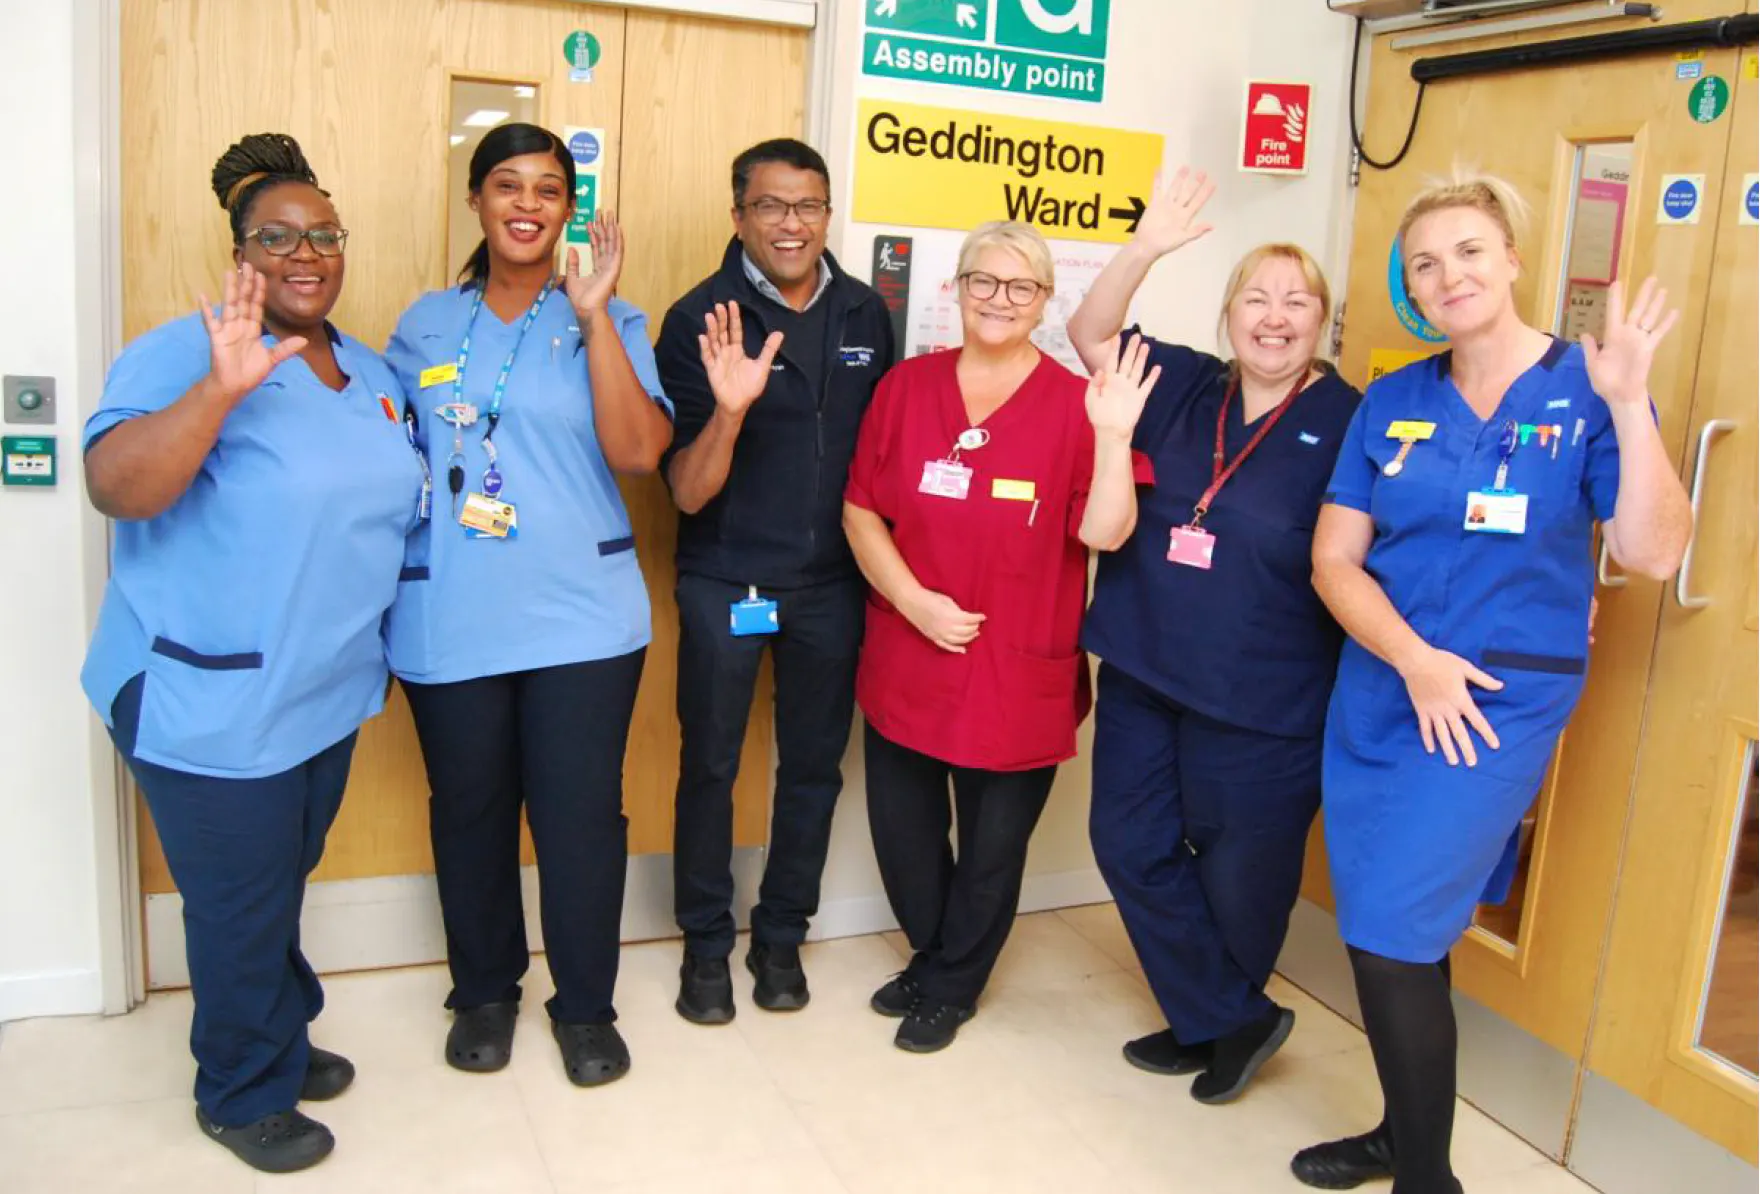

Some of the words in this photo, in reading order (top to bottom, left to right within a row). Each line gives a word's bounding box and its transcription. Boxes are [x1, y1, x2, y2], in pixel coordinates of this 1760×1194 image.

[873, 40, 1016, 87] Assembly
[1026, 64, 1096, 92] point
[867, 112, 1104, 178] Geddington
[1256, 153, 1290, 167] point
[1261, 138, 1287, 151] Fire
[1003, 183, 1101, 229] Ward
